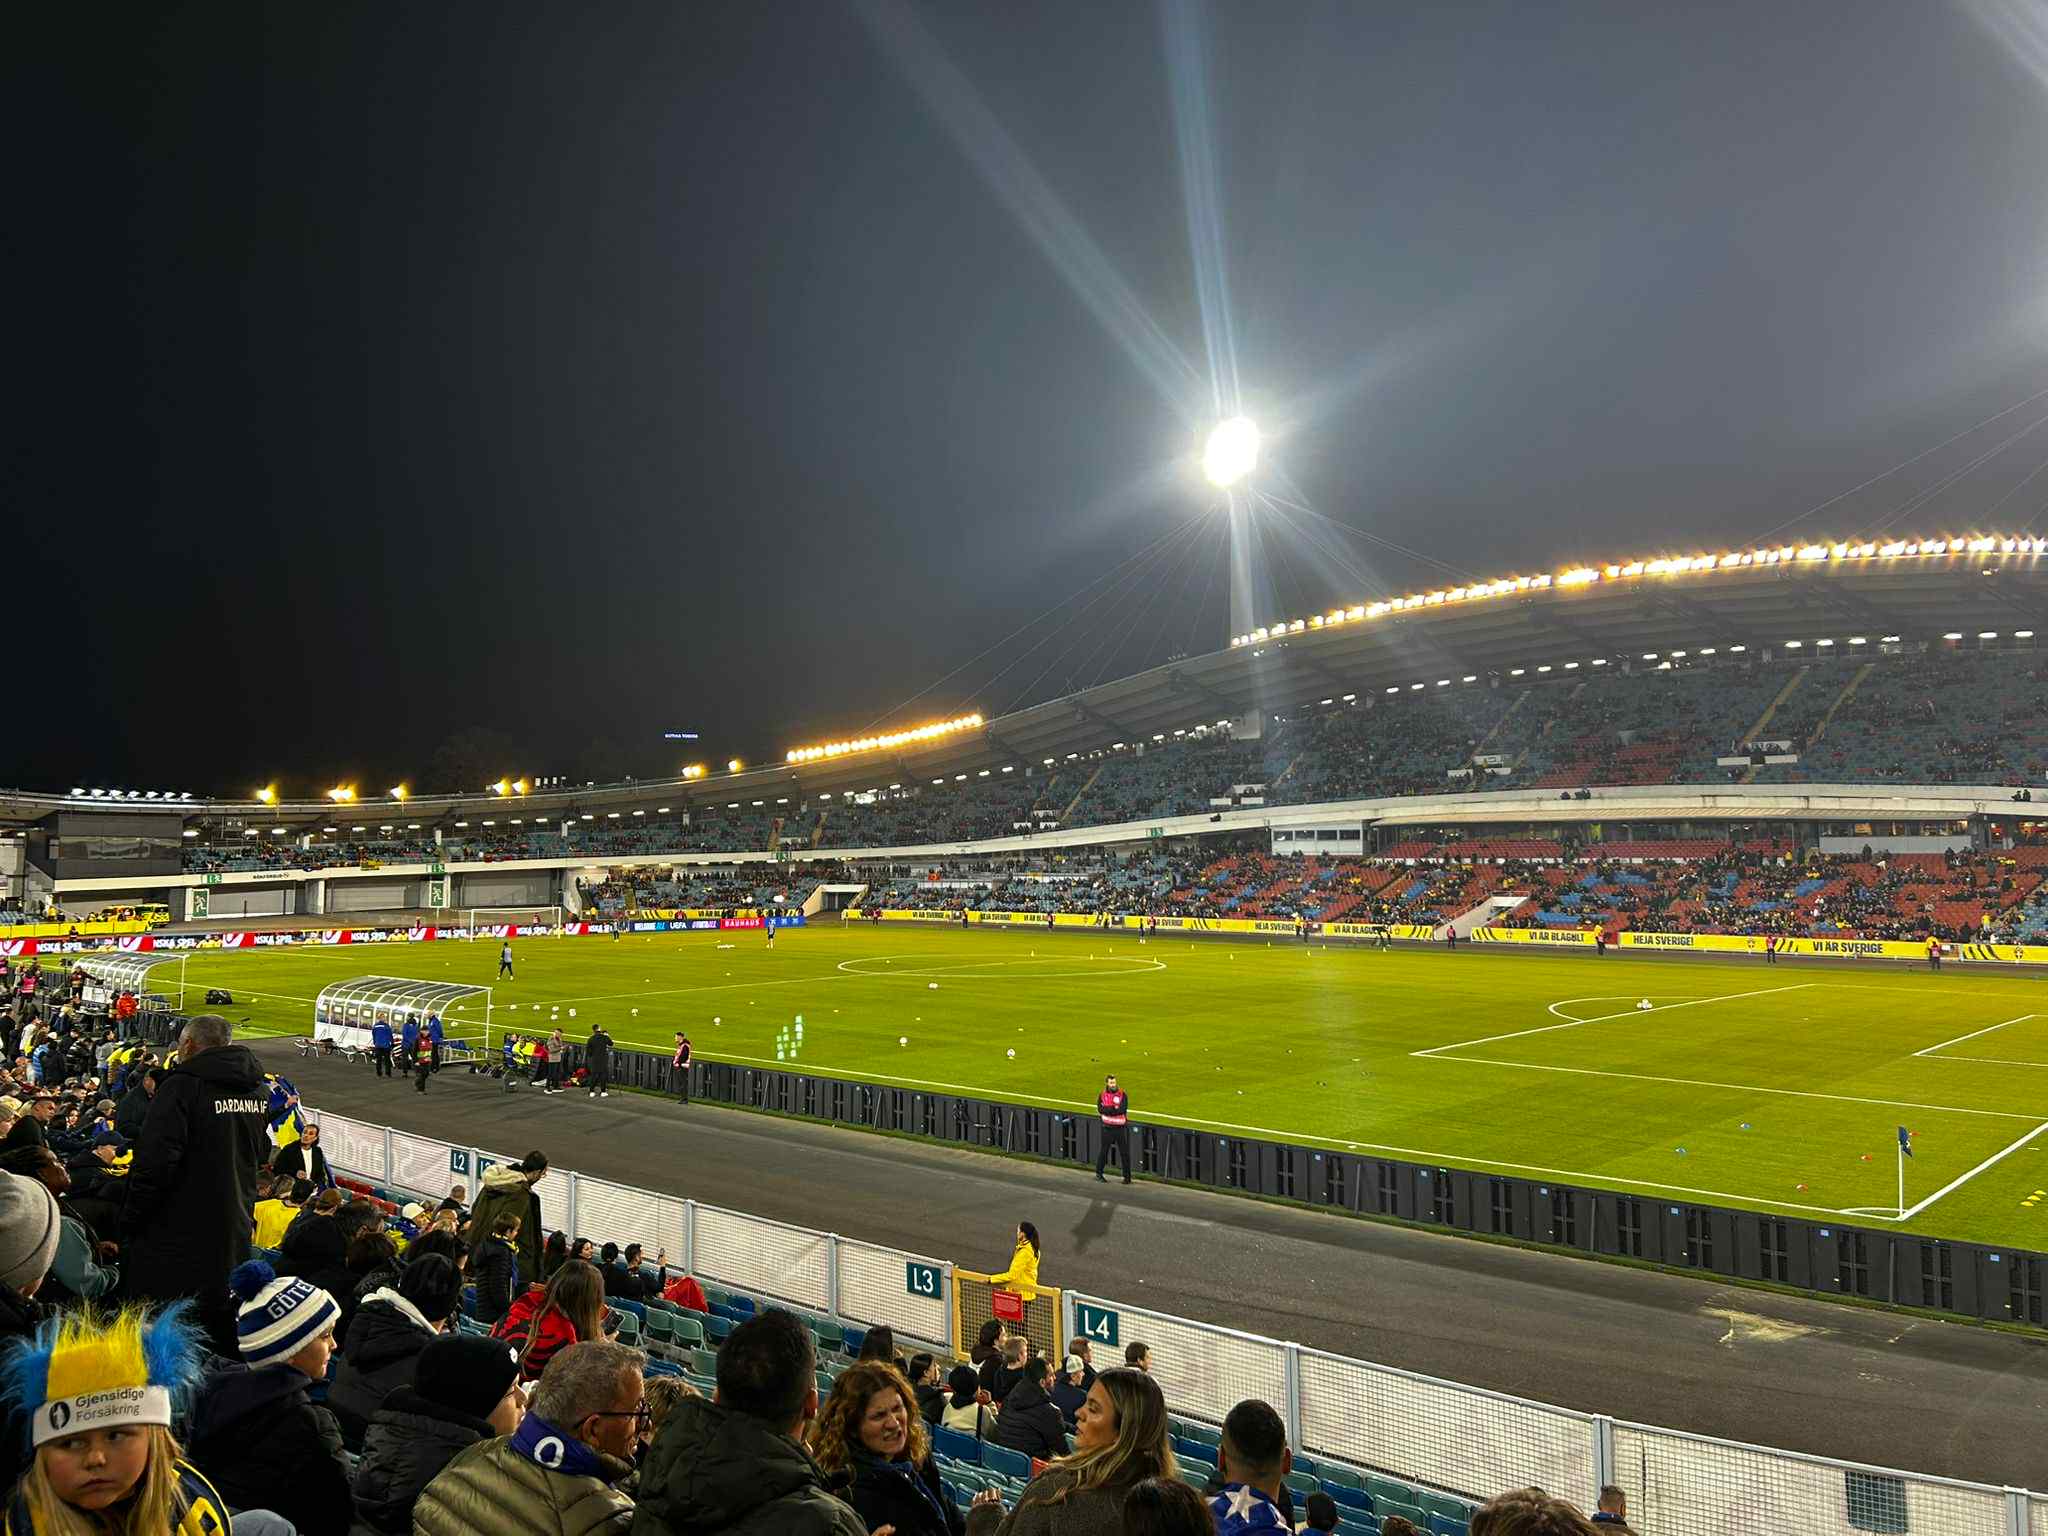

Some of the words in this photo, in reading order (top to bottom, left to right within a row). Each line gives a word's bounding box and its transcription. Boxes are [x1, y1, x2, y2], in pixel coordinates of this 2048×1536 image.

[724, 919, 760, 928] BAUHAUS
[1529, 930, 1538, 940] VI
[1633, 935, 1654, 945] HEJA
[1655, 936, 1694, 946] SVERIGE!
[1812, 941, 1825, 952] VI
[1825, 941, 1840, 953] ÄR
[1840, 942, 1883, 954] SVERIGE
[214, 1098, 259, 1114] DARDANIA
[453, 1152, 465, 1171] L2
[913, 1267, 935, 1293] L3
[1083, 1309, 1110, 1340] L4
[75, 1388, 145, 1408] Gjensidige
